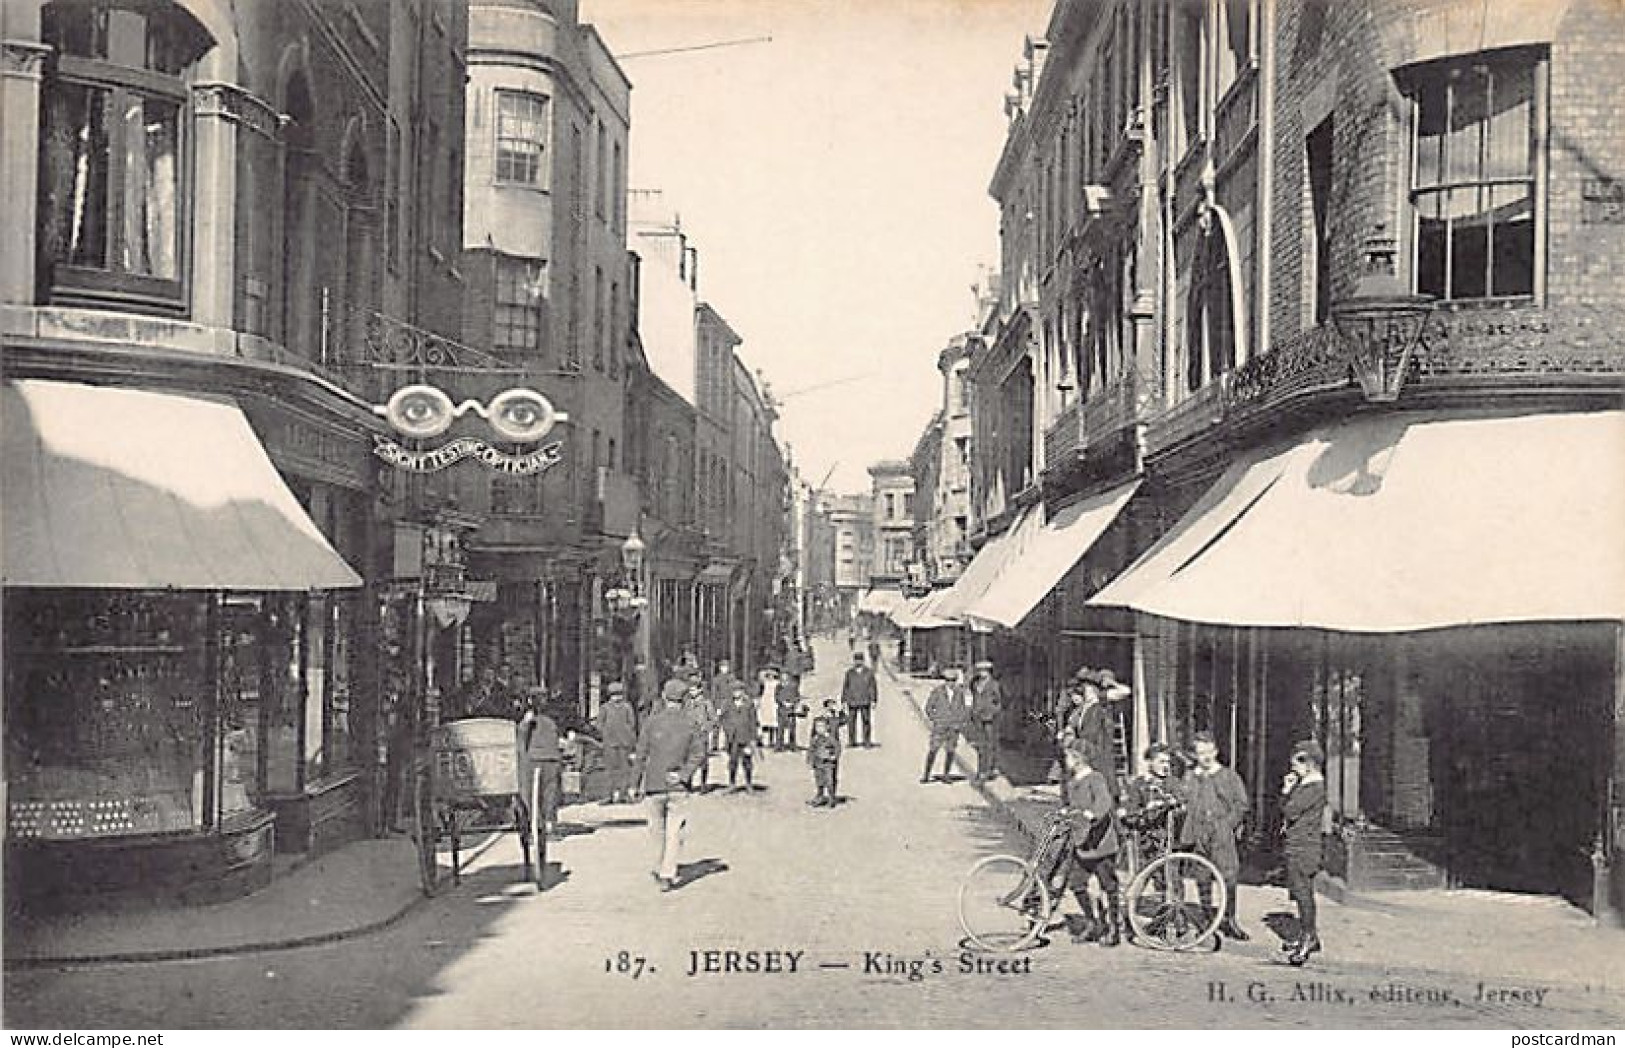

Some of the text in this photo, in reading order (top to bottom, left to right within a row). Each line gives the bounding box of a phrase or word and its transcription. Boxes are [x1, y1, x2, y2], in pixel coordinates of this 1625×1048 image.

[387, 440, 549, 474] SIGHT TESTING OPTICIAN
